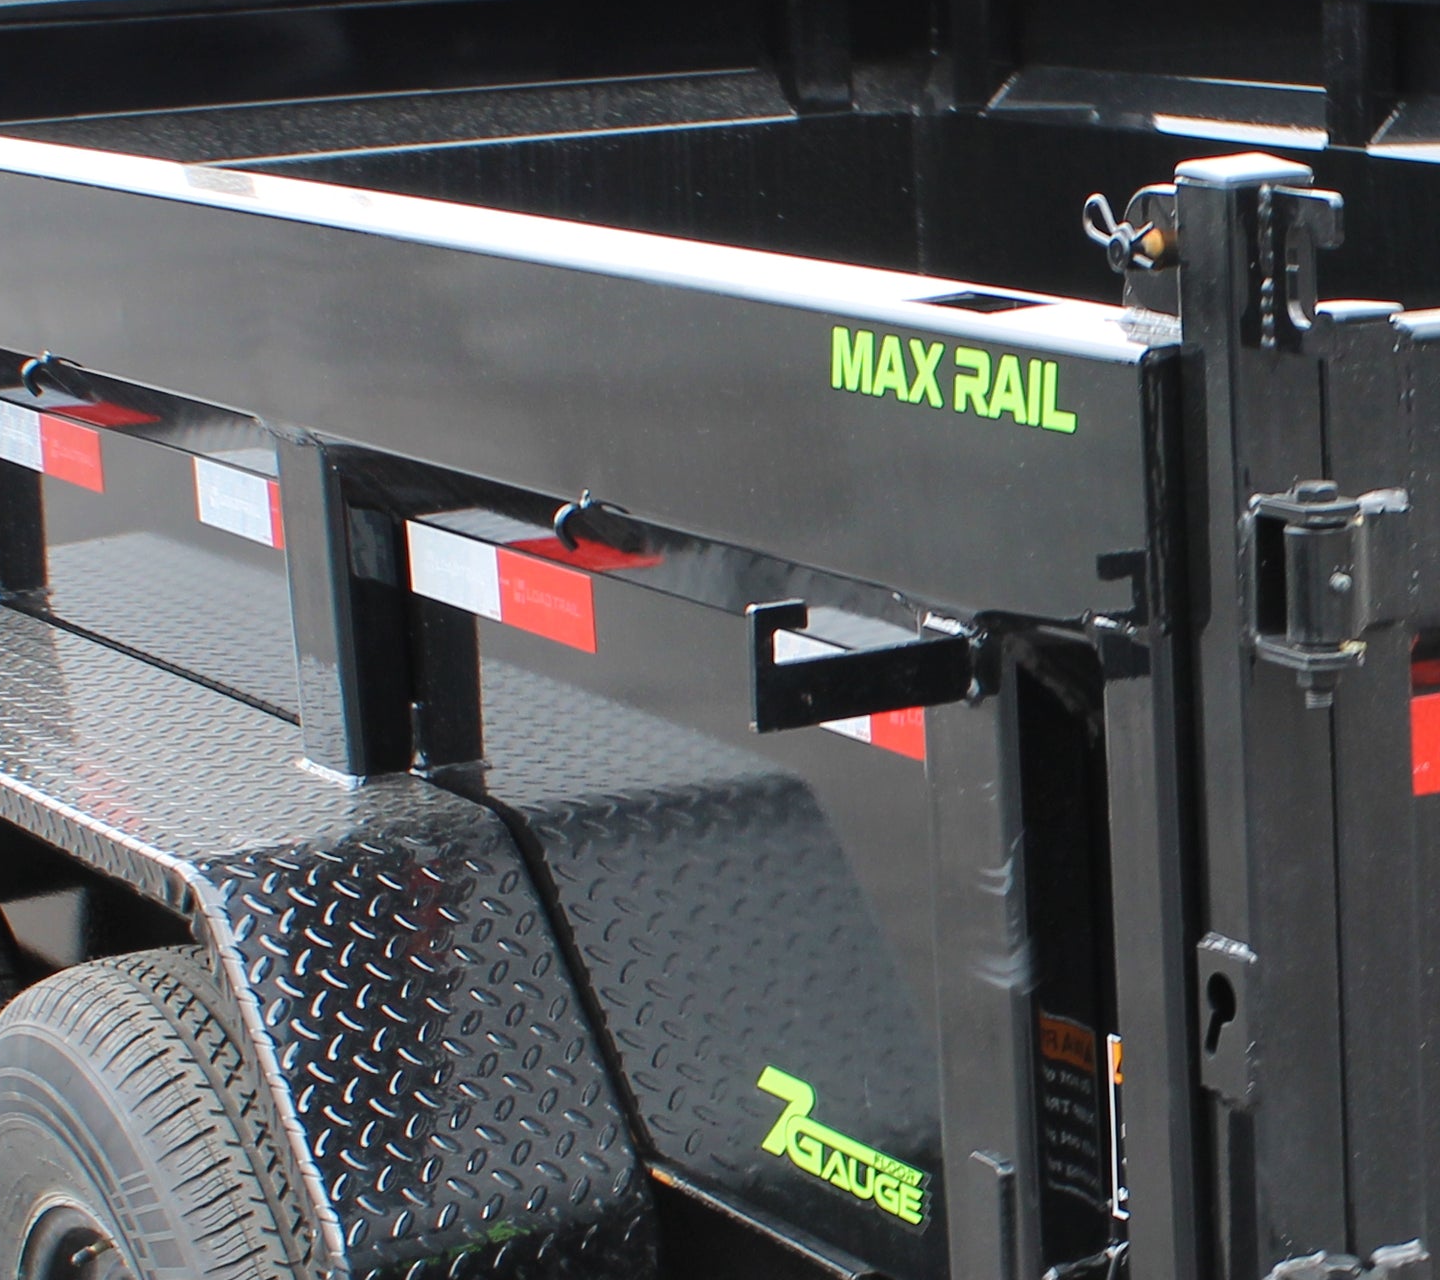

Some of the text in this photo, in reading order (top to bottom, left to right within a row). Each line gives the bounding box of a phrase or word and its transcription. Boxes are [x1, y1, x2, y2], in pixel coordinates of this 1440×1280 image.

[831, 325, 1078, 434] MAX RAIL
[756, 1065, 816, 1157] 7
[785, 1114, 924, 1225] GAUGE
